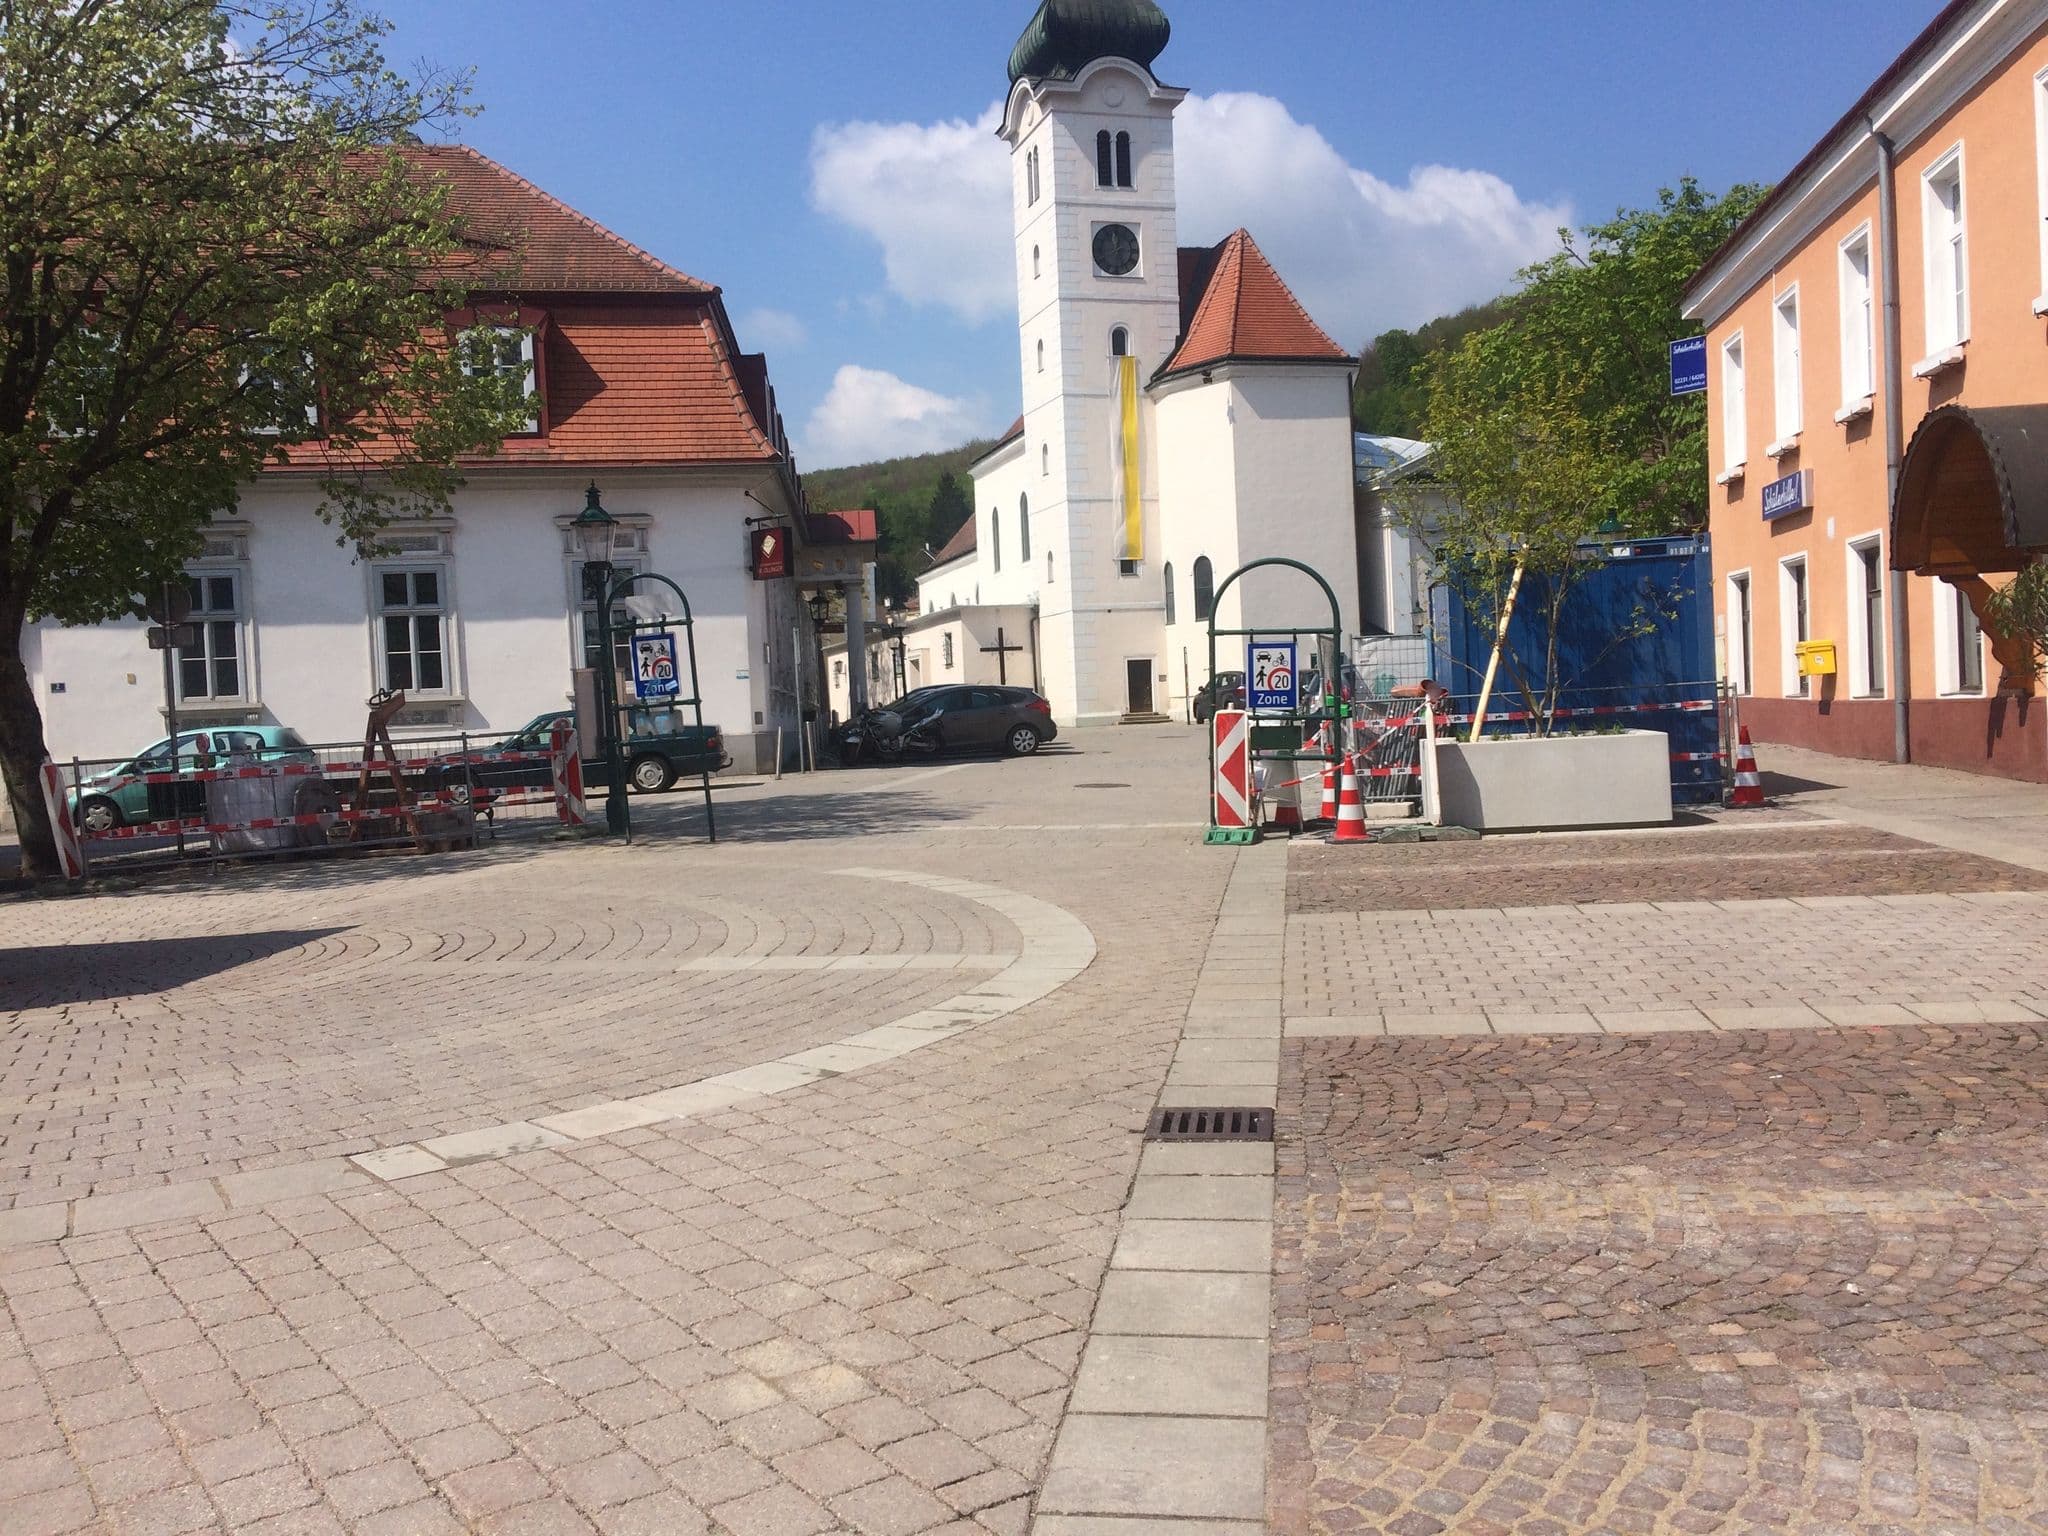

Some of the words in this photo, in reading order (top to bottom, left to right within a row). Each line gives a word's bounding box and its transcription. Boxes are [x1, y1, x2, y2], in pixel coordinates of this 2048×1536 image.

[657, 664, 672, 678] 20
[1274, 674, 1289, 689] 20
[1257, 693, 1288, 705] Zone
